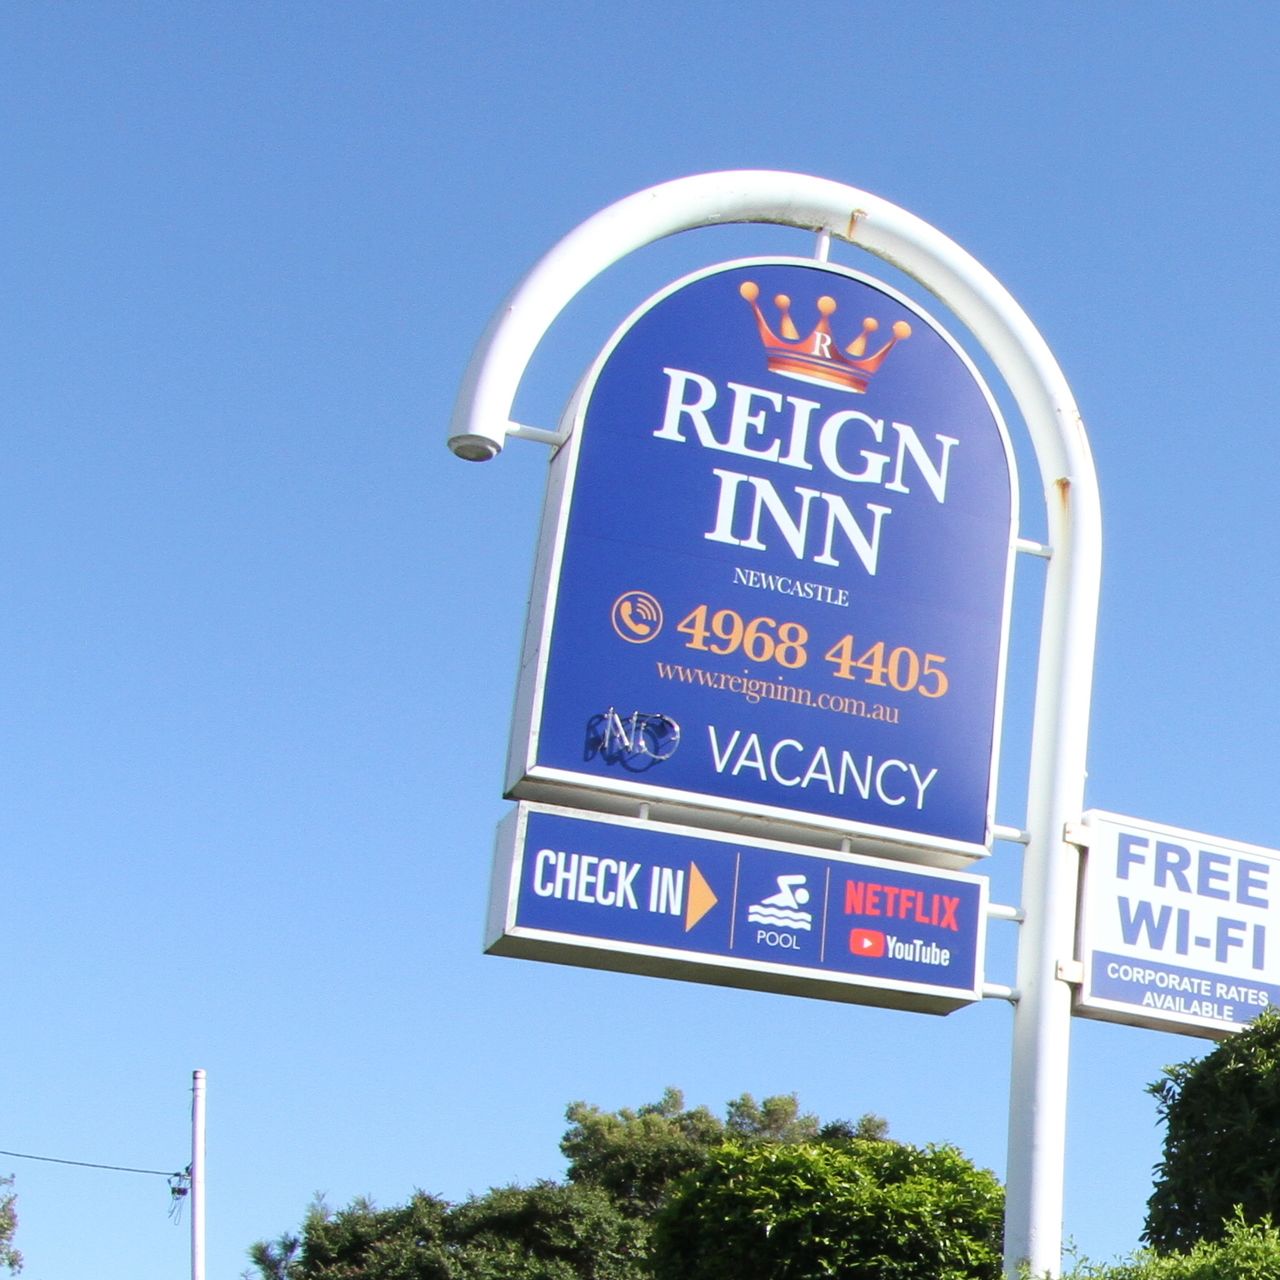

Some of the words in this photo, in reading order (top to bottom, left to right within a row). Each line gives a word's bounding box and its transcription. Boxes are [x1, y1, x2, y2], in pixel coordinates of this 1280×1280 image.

[811, 331, 832, 359] R
[653, 367, 960, 503] REIGN
[704, 468, 892, 576] INN
[733, 567, 850, 607] NEWCASTLE
[677, 605, 808, 668] 4968
[825, 635, 949, 698] 4405
[656, 661, 900, 724] www.reigninn.com.au
[707, 725, 938, 810] VACANCY
[533, 848, 641, 910] CHECK
[649, 866, 684, 916] IN
[1116, 832, 1270, 910] FREE
[844, 880, 960, 932] NETFLIX
[1117, 895, 1266, 971] WI-FI
[757, 930, 800, 950] POOL
[886, 937, 950, 967] YouTube
[1107, 962, 1212, 997] CORPORATE
[1216, 982, 1269, 1006] RATES
[1142, 991, 1233, 1022] AVAILABLE
